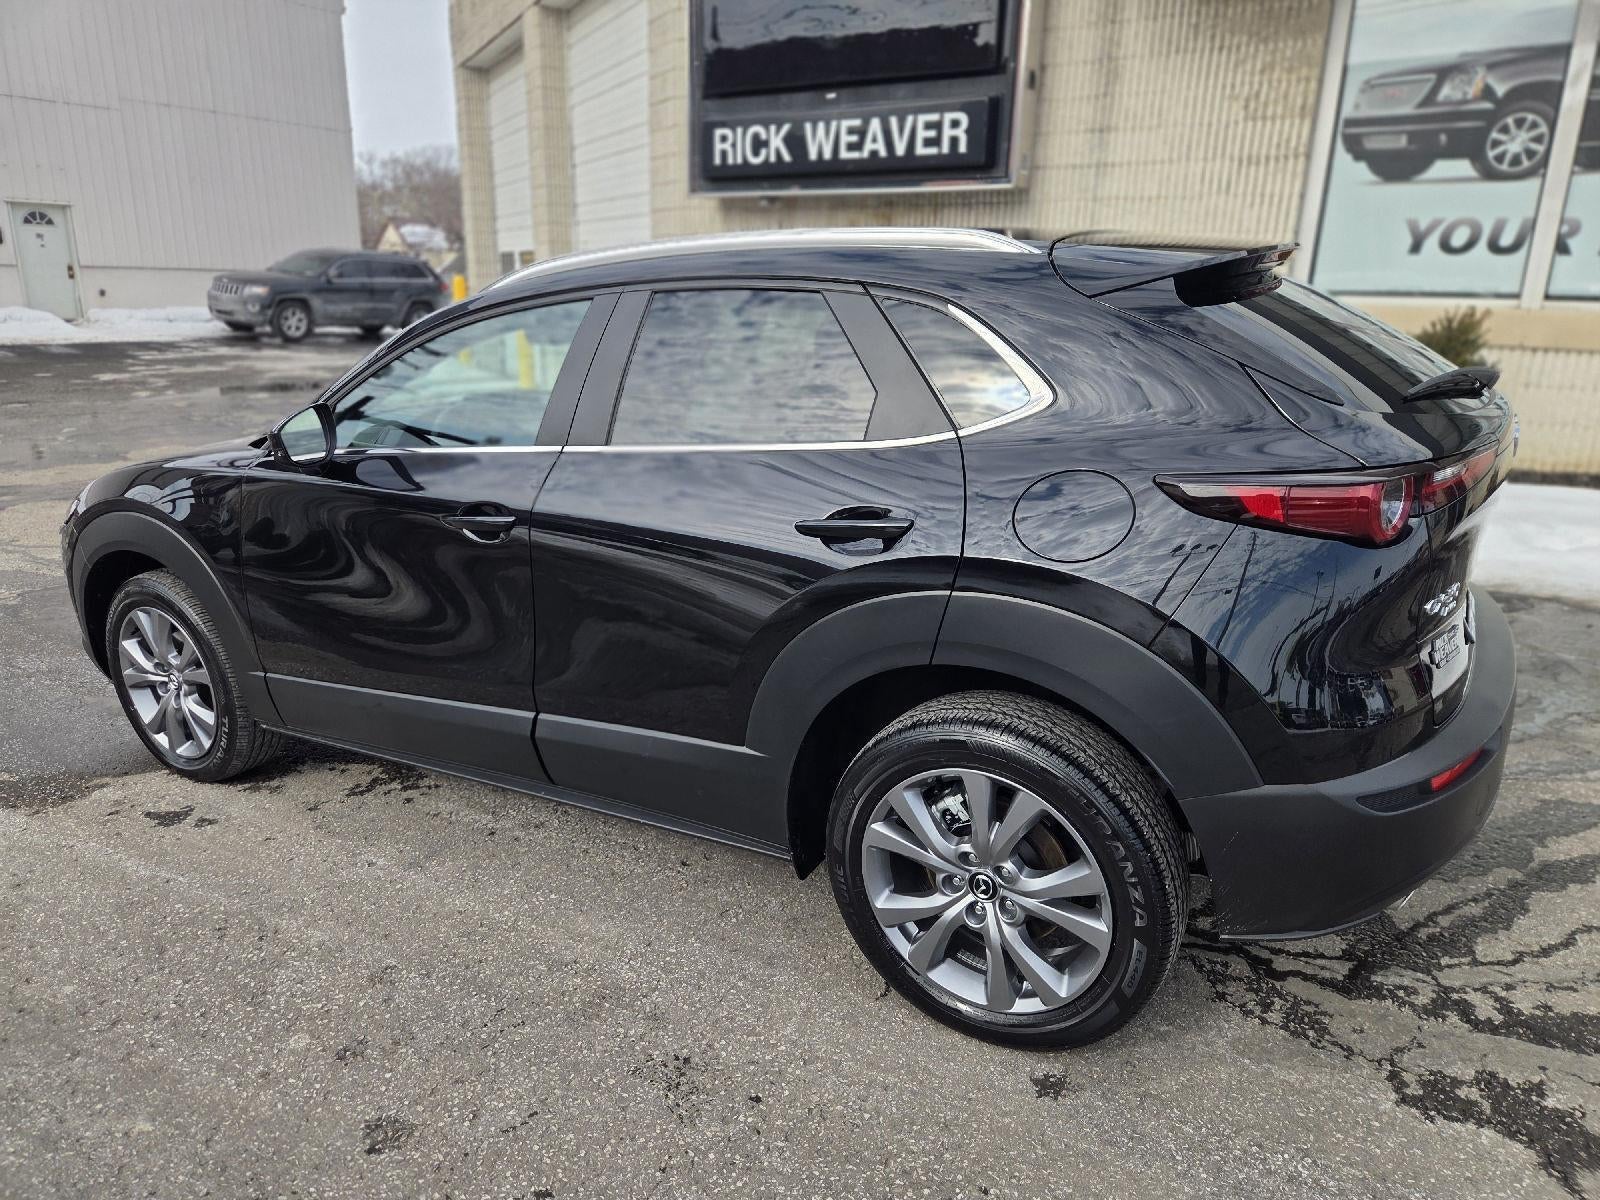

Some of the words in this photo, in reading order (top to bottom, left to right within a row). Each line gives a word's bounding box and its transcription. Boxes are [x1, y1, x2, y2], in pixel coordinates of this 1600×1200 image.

[713, 122, 792, 166] RICK
[804, 110, 969, 162] WEAVER
[1405, 216, 1582, 257] YOUR
